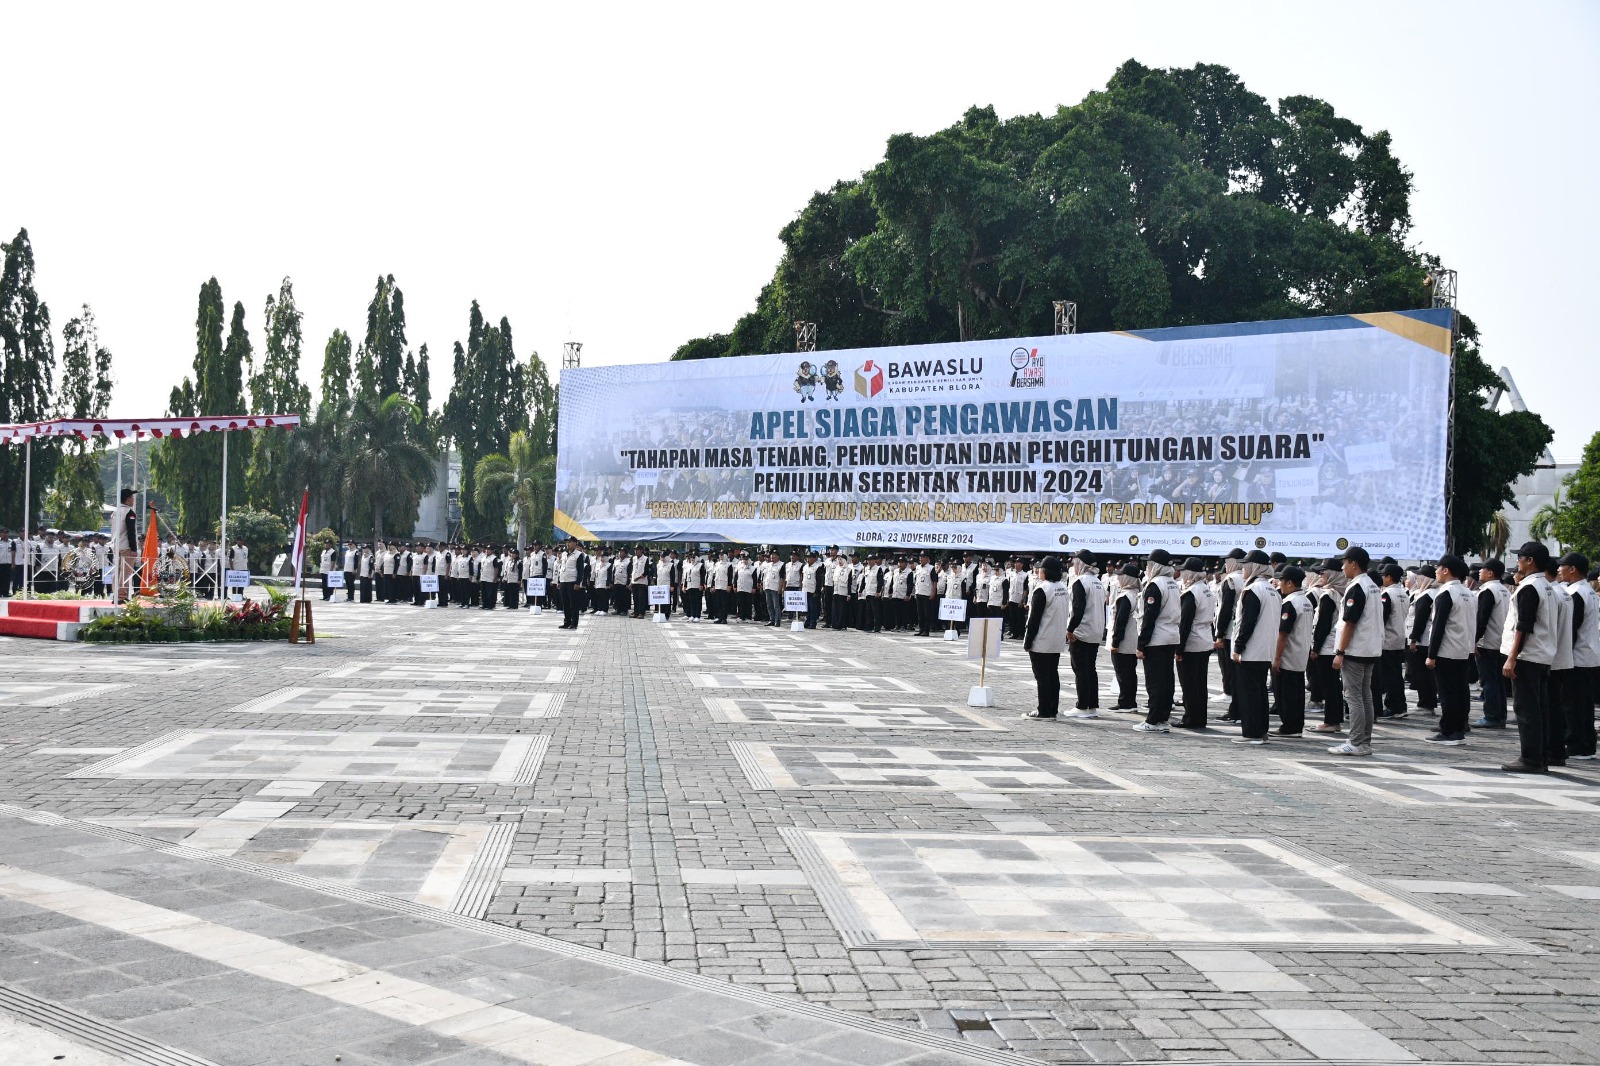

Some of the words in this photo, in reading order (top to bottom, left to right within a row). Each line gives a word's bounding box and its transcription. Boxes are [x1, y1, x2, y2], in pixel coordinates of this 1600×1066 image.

[889, 357, 983, 379] BAWASLU
[1031, 356, 1044, 367] AYO
[889, 385, 944, 394] KABUPATEN
[949, 383, 981, 391] BLORA
[1016, 377, 1044, 388] BERSAMA
[750, 410, 809, 440] APEL
[815, 406, 899, 439] SIAGA
[905, 397, 1118, 436] PENGAWASAN
[620, 448, 700, 469] "TAHAPAN
[704, 447, 753, 468] MASA
[757, 445, 832, 469] TENANG,
[836, 442, 972, 467] PEMUNGUTAN
[978, 441, 1021, 464] DAN
[1027, 436, 1213, 464] PENGHITUNGAN
[1220, 433, 1325, 460] SUARA"
[753, 471, 854, 493] PEMILIHAN
[858, 470, 961, 494] SERENTAK
[966, 470, 1037, 493] TAHUN
[1043, 470, 1103, 493] 2024
[711, 501, 758, 519] RAKYAT
[760, 501, 802, 520] AWASI
[805, 501, 858, 521] PEMILU
[860, 501, 930, 521] BERSAMA
[933, 502, 1007, 523] BAWASLU
[1011, 502, 1096, 524] TEGAKKAN
[1100, 502, 1185, 525] KEADILAN
[855, 532, 886, 543] BLORA,
[887, 532, 898, 543] 23
[901, 532, 949, 544] NOVEMBER
[951, 534, 974, 545] 2024
